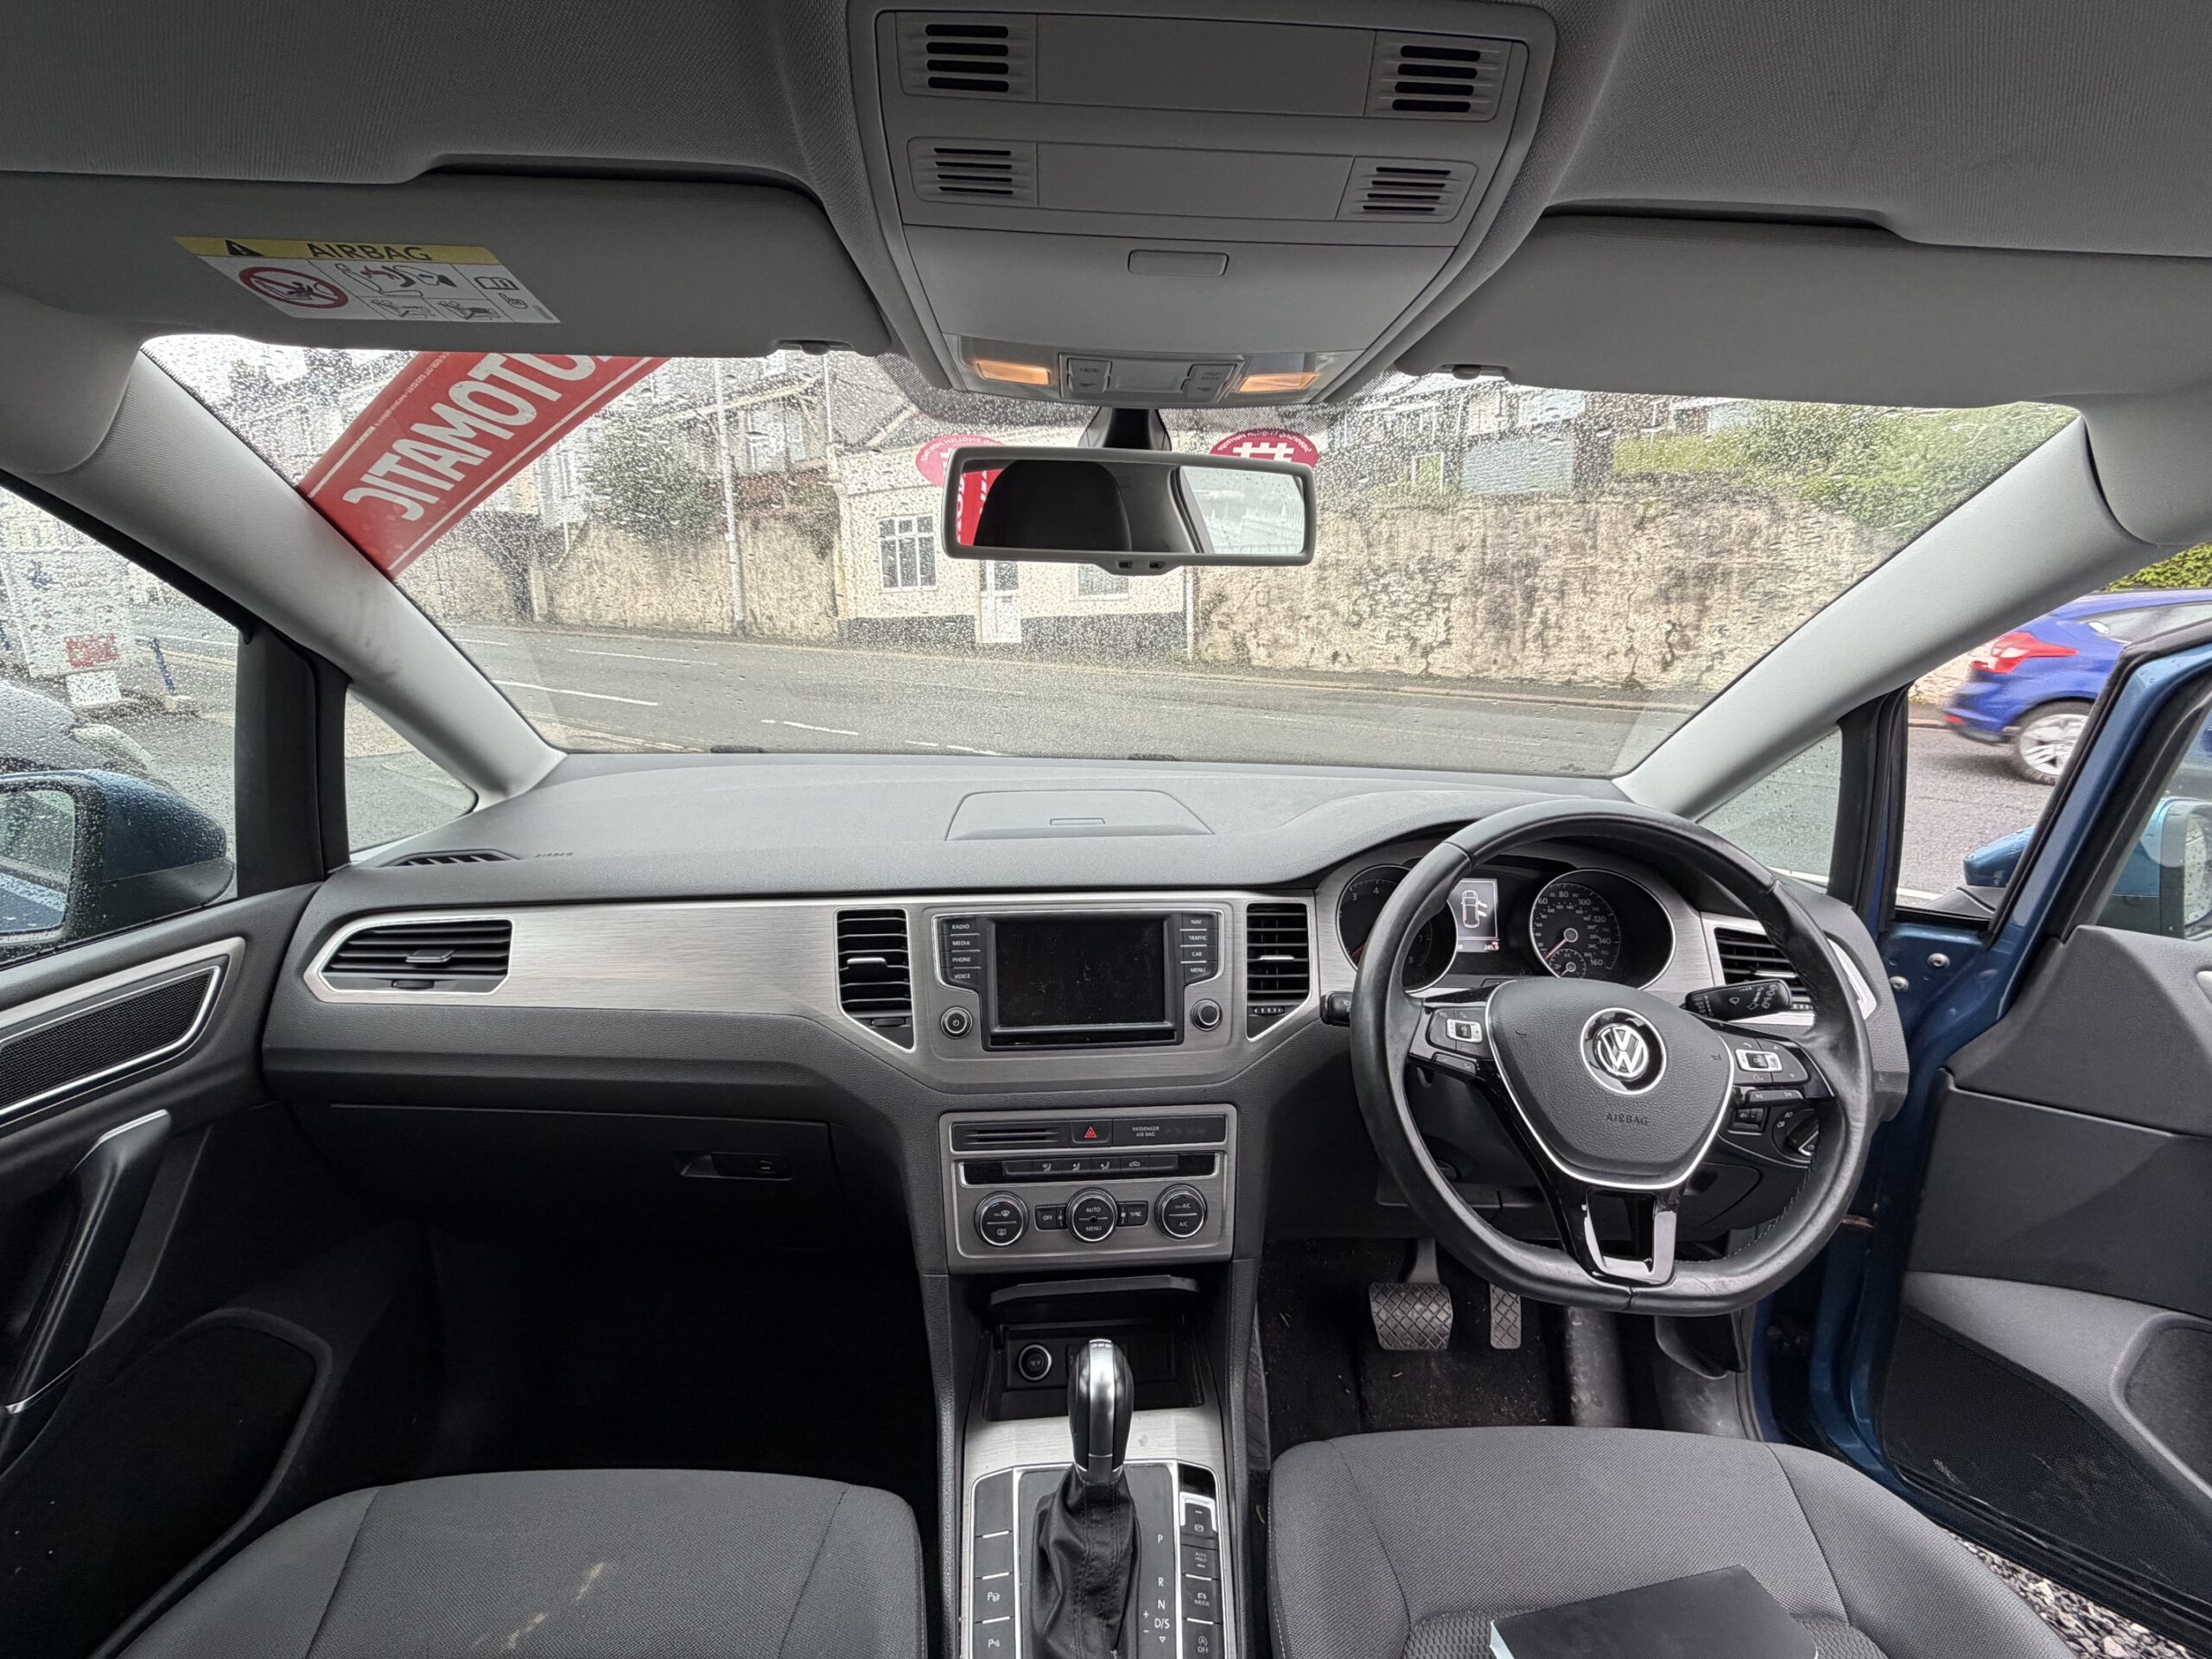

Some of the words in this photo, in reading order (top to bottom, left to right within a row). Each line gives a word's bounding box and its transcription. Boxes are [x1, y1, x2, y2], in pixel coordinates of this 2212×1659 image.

[307, 243, 433, 261] AIRBAG
[1606, 1112, 1649, 1125] AIRBAG
[1158, 1534, 1163, 1543] P
[1158, 1577, 1164, 1586] R
[1158, 1599, 1166, 1610] N
[1154, 1618, 1170, 1629] D/S
[1198, 1645, 1209, 1654] OFF
